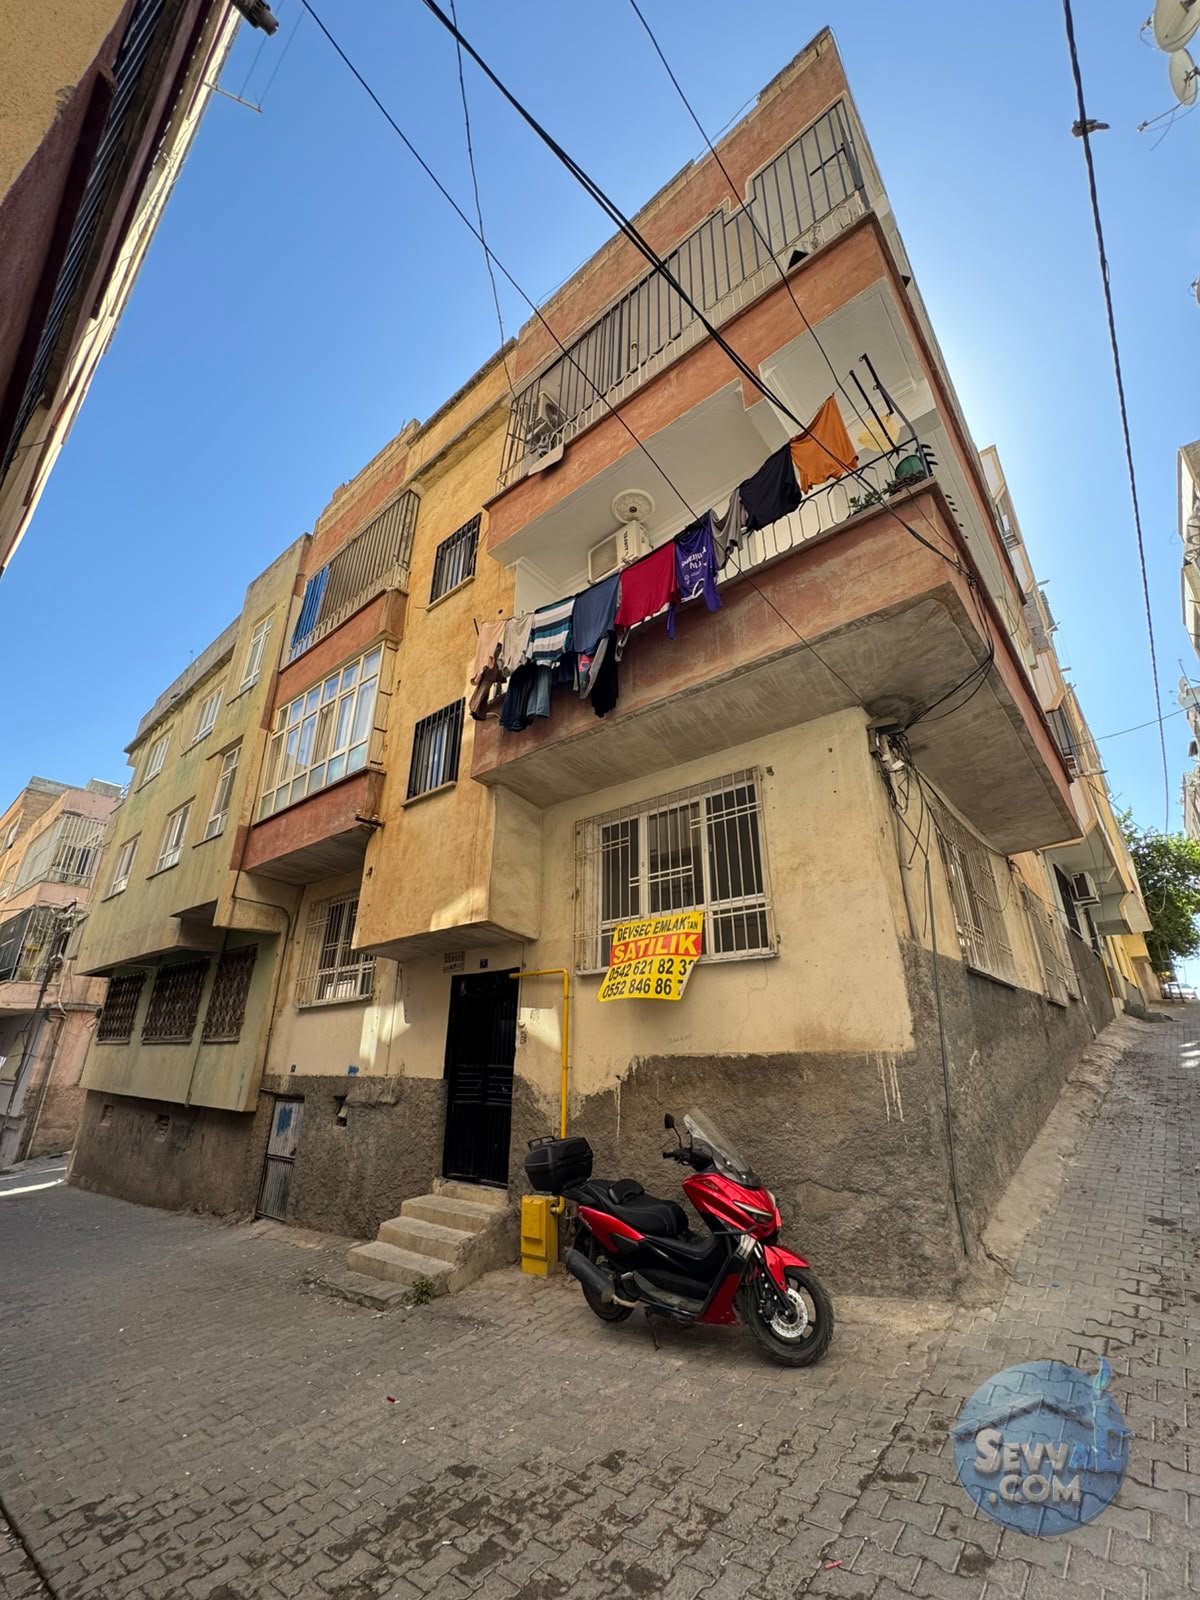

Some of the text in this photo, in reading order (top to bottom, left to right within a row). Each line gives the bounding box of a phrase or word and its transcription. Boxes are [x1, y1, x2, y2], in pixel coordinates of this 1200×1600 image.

[612, 933, 700, 964] SATILIK
[608, 963, 632, 981] 0542
[633, 959, 654, 975] 621
[657, 958, 674, 975] 82
[602, 980, 627, 999] 0552
[628, 977, 651, 994] 846
[655, 977, 672, 995] 86
